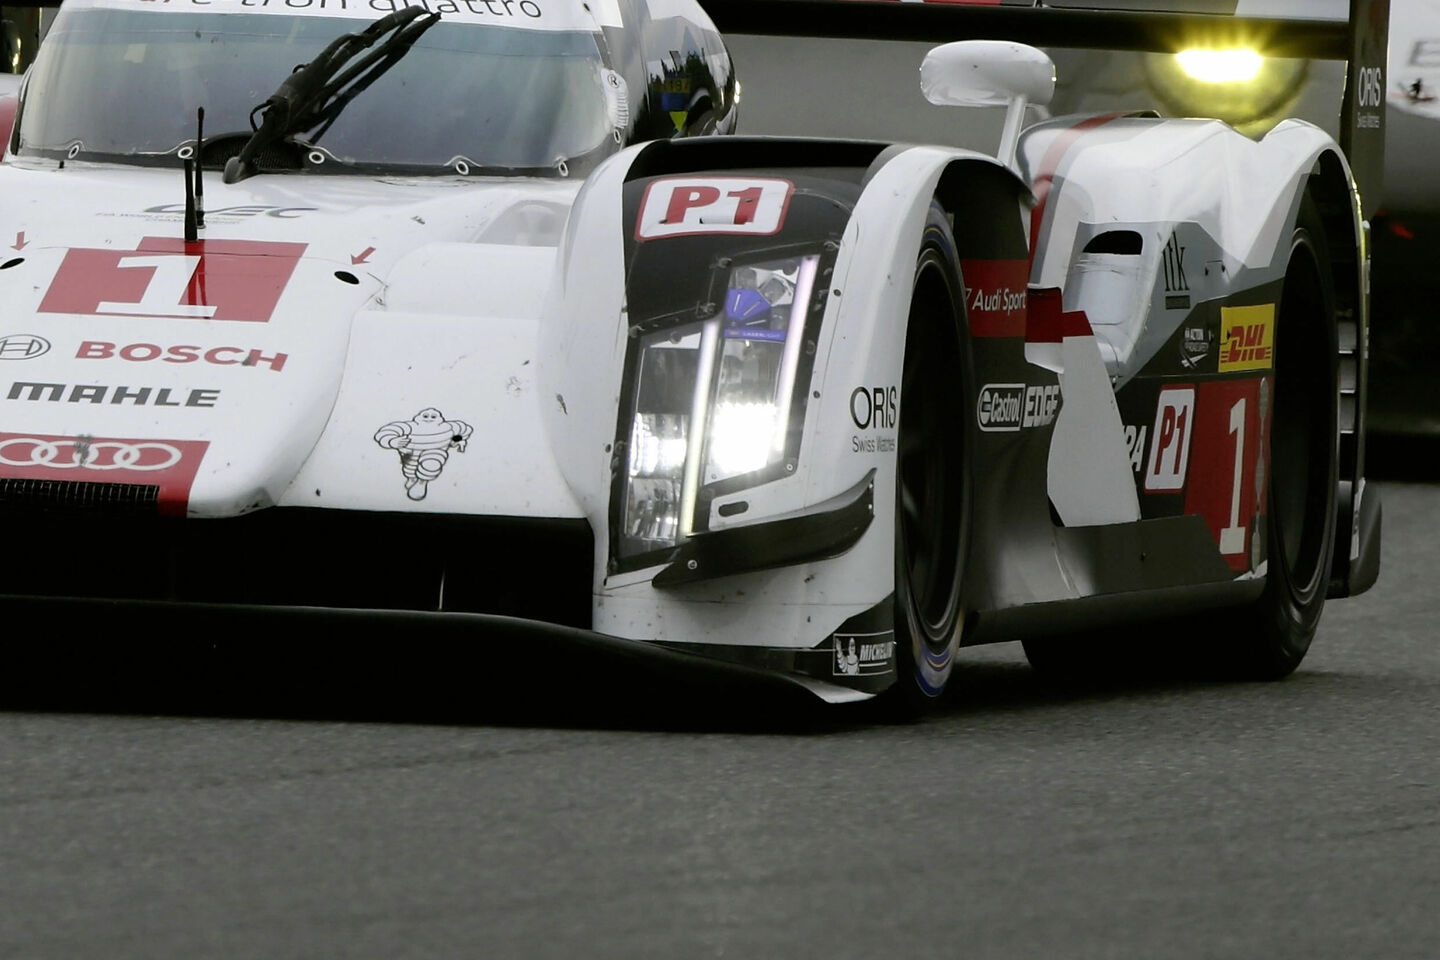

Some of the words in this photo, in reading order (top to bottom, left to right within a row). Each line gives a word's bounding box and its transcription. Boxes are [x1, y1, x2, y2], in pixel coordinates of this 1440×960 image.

[1358, 66, 1382, 107] ORIS
[665, 185, 764, 225] P1
[95, 255, 218, 318] 1
[972, 287, 1002, 312] Audi
[1002, 288, 1027, 316] Sport
[75, 340, 289, 372] BOSCH
[1225, 324, 1267, 363] DHL
[7, 381, 221, 408] MAHLE
[850, 385, 897, 430] ORIS
[990, 392, 1022, 423] Castrol
[1022, 385, 1060, 427] EDGE
[852, 435, 876, 453] Swiss
[1154, 405, 1188, 475] P1
[1219, 398, 1247, 555] 1
